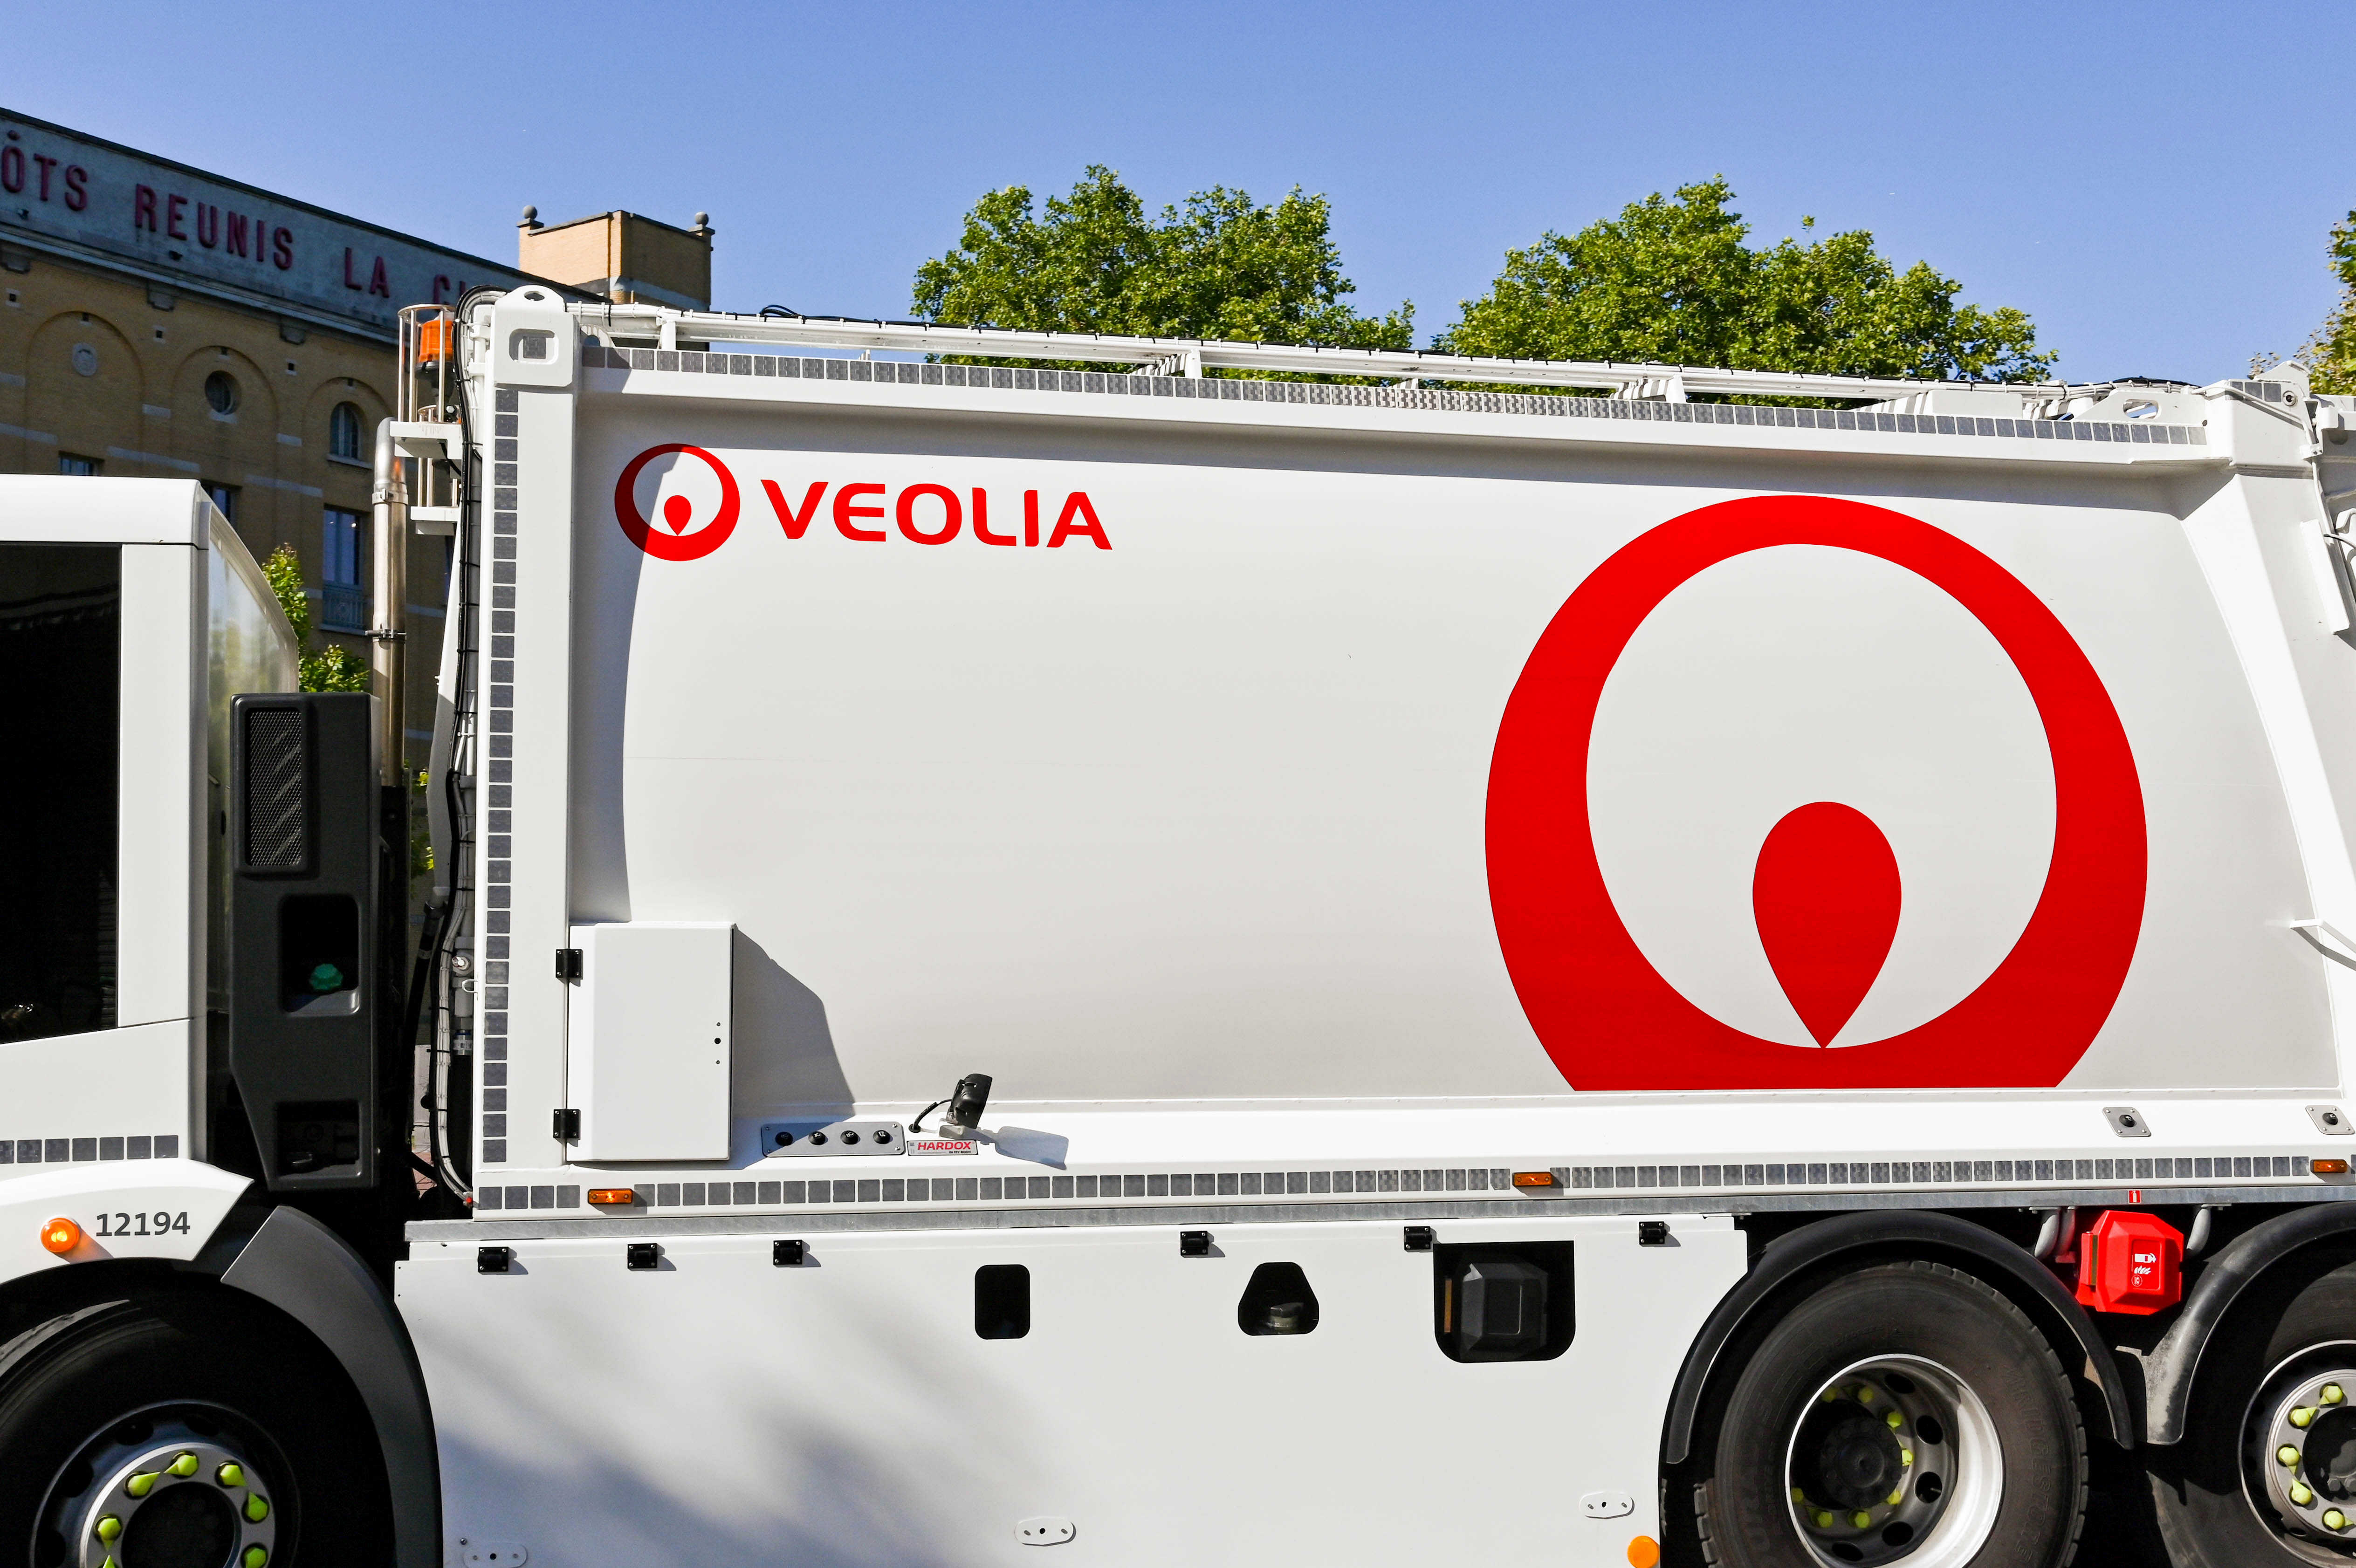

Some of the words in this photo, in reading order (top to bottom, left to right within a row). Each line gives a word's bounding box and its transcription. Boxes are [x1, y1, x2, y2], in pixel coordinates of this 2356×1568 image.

[135, 184, 293, 270] REUNIS
[345, 247, 390, 299] LA
[761, 479, 1113, 550] VEOLIA
[918, 1142, 971, 1150] HARDOX
[96, 1212, 191, 1237] 12194
